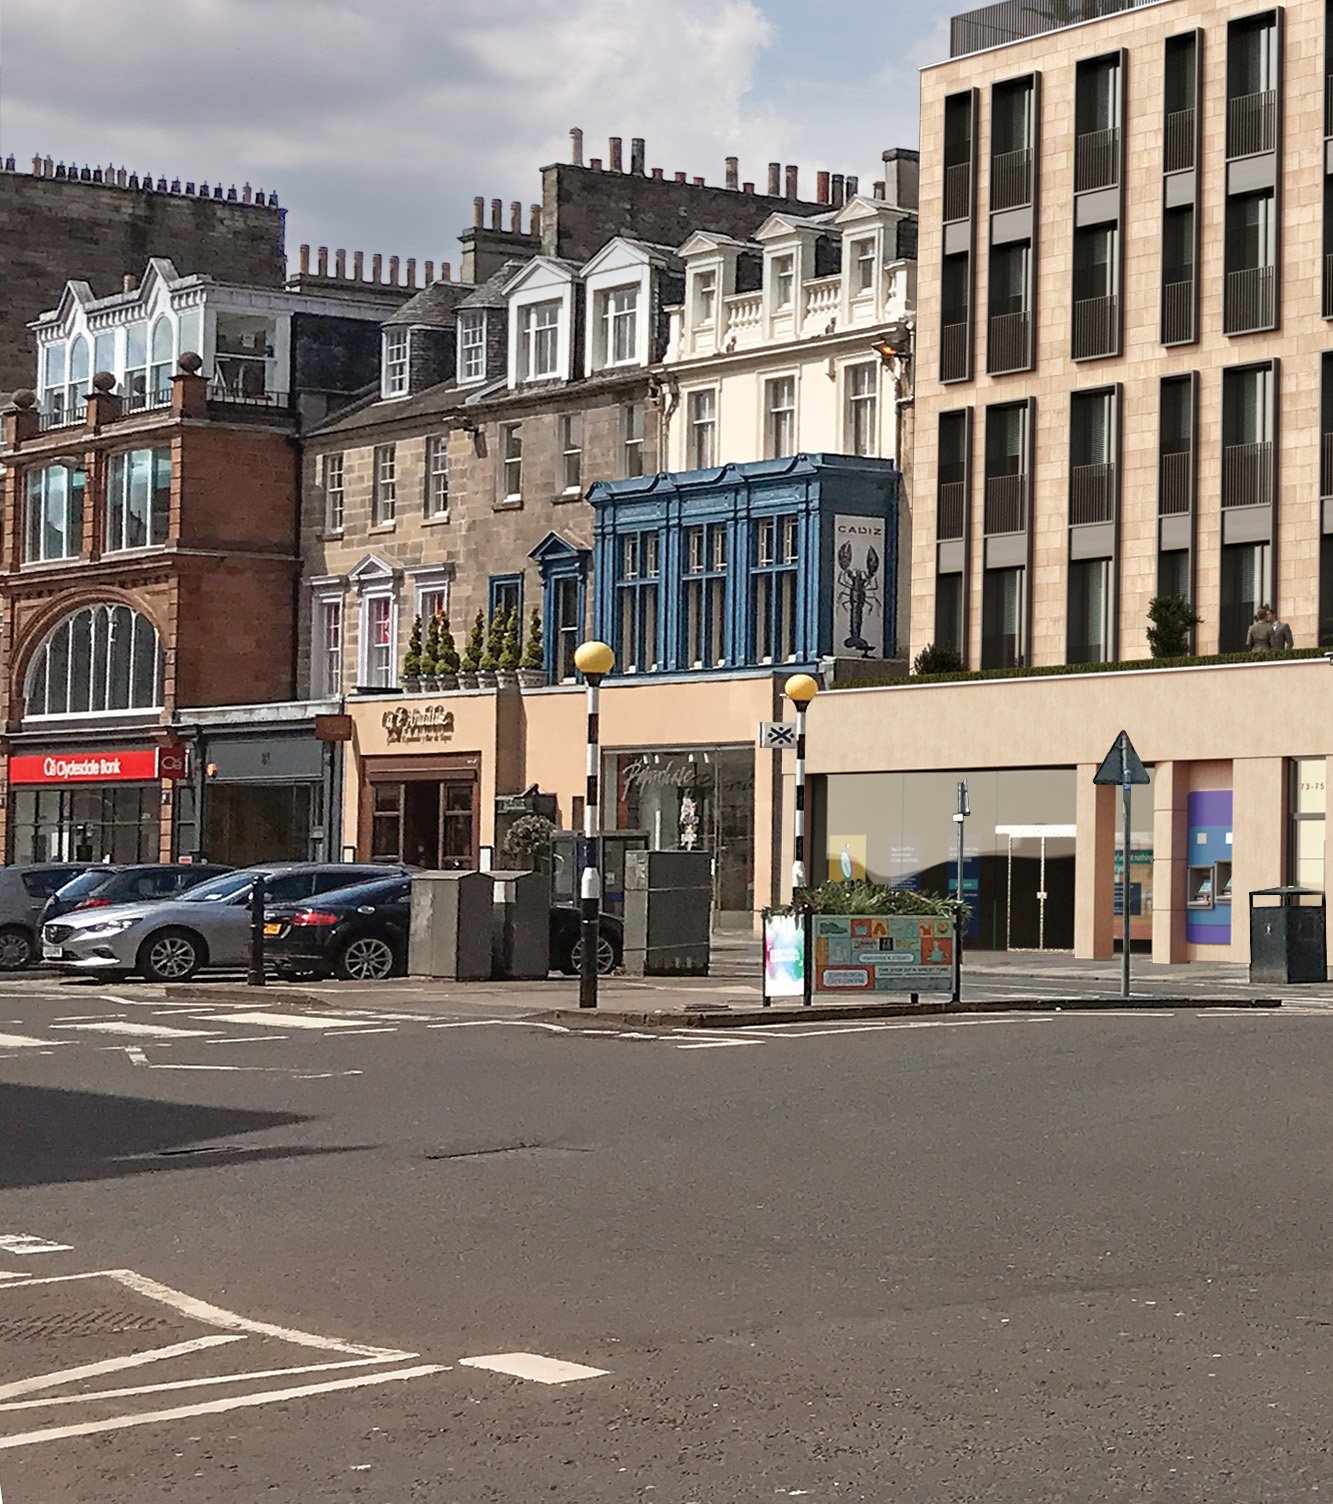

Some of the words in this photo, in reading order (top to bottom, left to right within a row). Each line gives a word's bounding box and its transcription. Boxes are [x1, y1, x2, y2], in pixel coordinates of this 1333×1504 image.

[838, 526, 882, 535] CADIZ
[57, 760, 100, 779] Clydesdale
[101, 758, 121, 774] Bank
